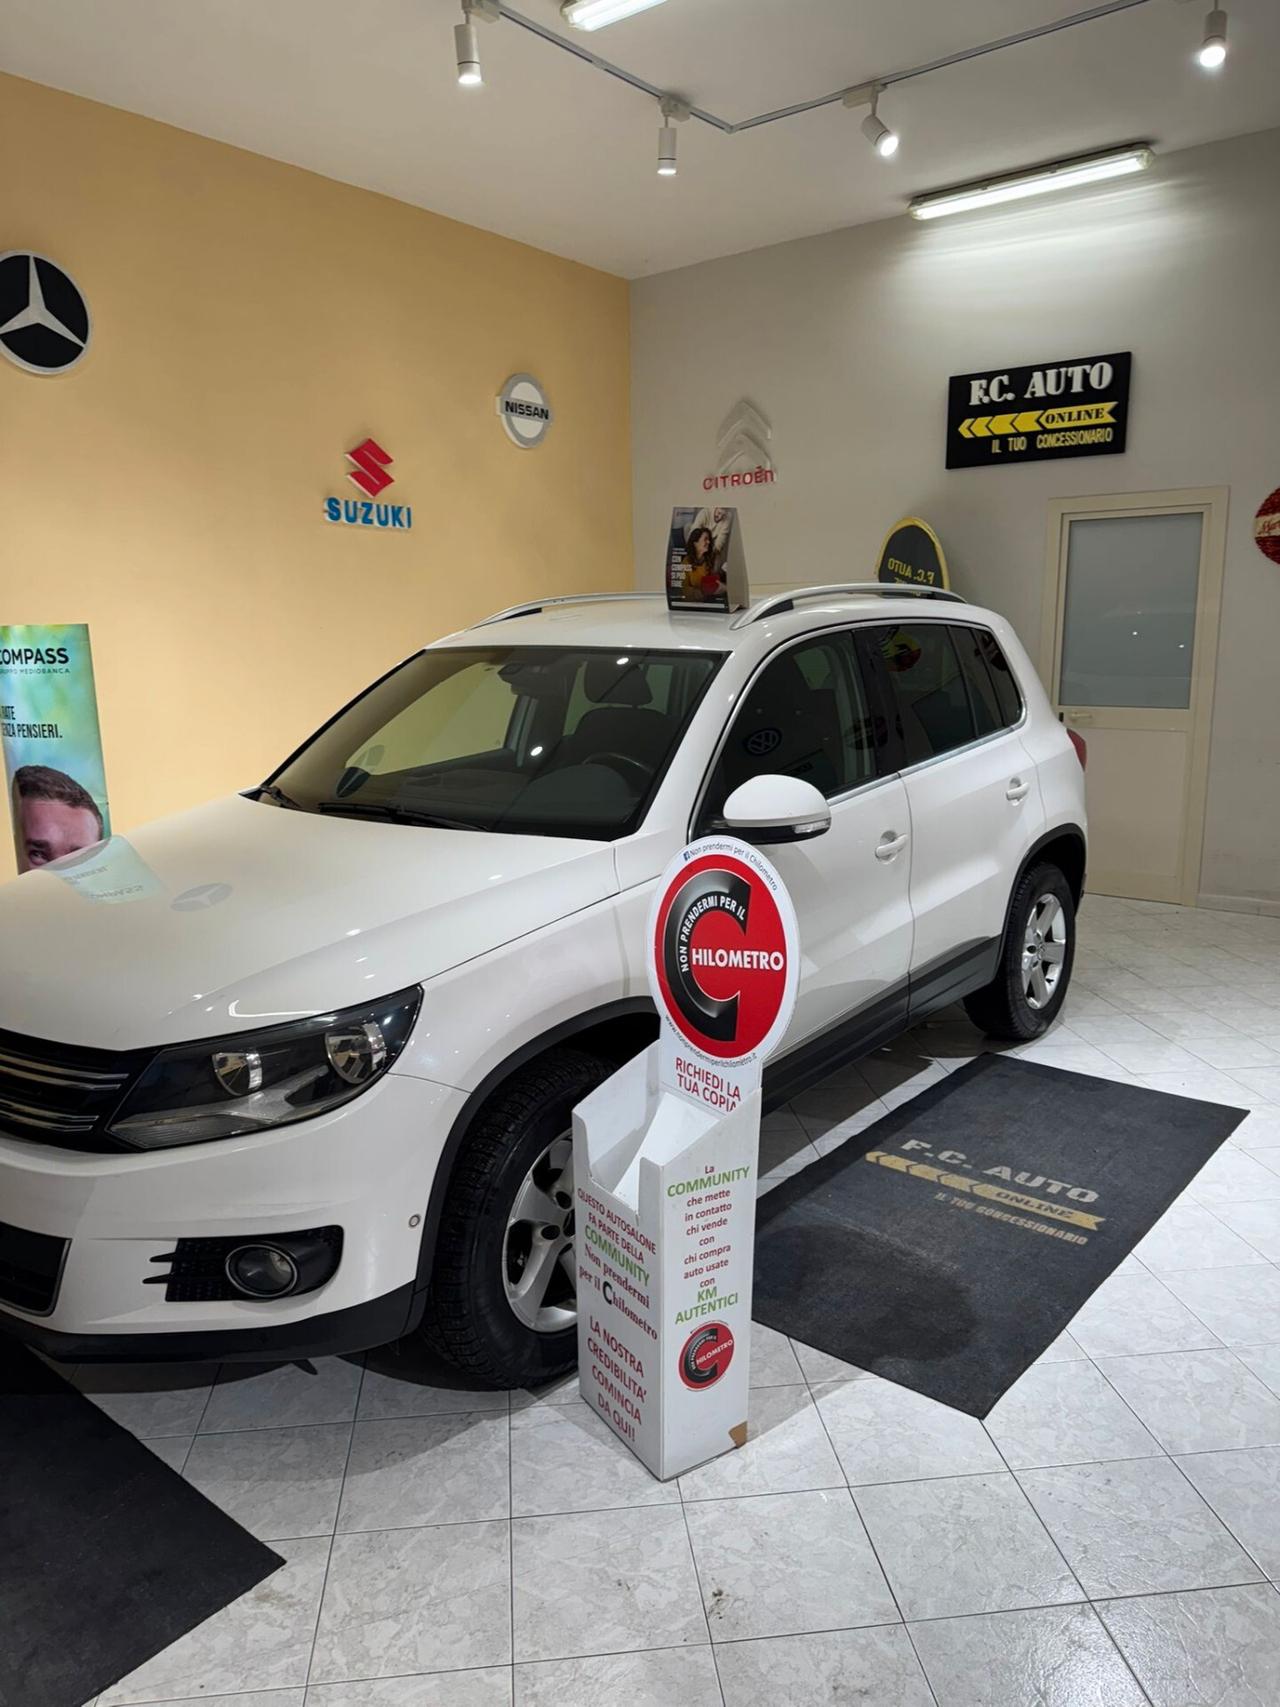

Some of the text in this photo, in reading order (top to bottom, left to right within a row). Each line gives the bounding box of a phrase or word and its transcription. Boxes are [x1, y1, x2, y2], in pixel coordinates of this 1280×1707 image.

[968, 362, 1113, 405] F.C. AUTO
[505, 401, 549, 419] NISSAN
[1045, 408, 1105, 425] ONLINE
[991, 428, 1113, 453] IL TUO CONCESSIONARIO
[326, 497, 412, 529] SUZUKI
[0, 647, 69, 665] OMPASS
[17, 723, 63, 739] PENSIERI.
[679, 895, 746, 972] NON PRENDERMI PER IL
[692, 948, 784, 971] HILOMETRO
[675, 1057, 741, 1101] RICHIEDI LA
[677, 1073, 737, 1113] TUA COPIA
[667, 1166, 750, 1198] COMMUNITY
[704, 1165, 715, 1174] La
[900, 1139, 1100, 1203] F.C. AUTO
[684, 1203, 732, 1222] in contatto
[686, 1189, 731, 1207] che mette
[996, 1190, 1073, 1219] ONLINE
[577, 1187, 657, 1255] QUESTO AUTOSALONE
[686, 1217, 728, 1236] chi vende
[933, 1191, 947, 1200] IL
[976, 1204, 1089, 1246] CONCESSIONARIO
[588, 1212, 645, 1264] FA PARTE DELLA
[699, 1235, 715, 1246] con
[584, 1224, 650, 1287] COMMUNITY
[683, 1259, 729, 1279] auto usate
[684, 1244, 731, 1265] chi compra
[584, 1243, 650, 1310] Non prendermi
[699, 1277, 715, 1288] con
[579, 1266, 593, 1283] per
[602, 1280, 658, 1341] Chilometro
[675, 1292, 738, 1325] AUTENTICI
[697, 1287, 718, 1302] KM
[589, 1315, 645, 1378] LA NOSTRA
[591, 1365, 642, 1425] COMINCIA
[597, 1392, 636, 1442] DA QUI!
